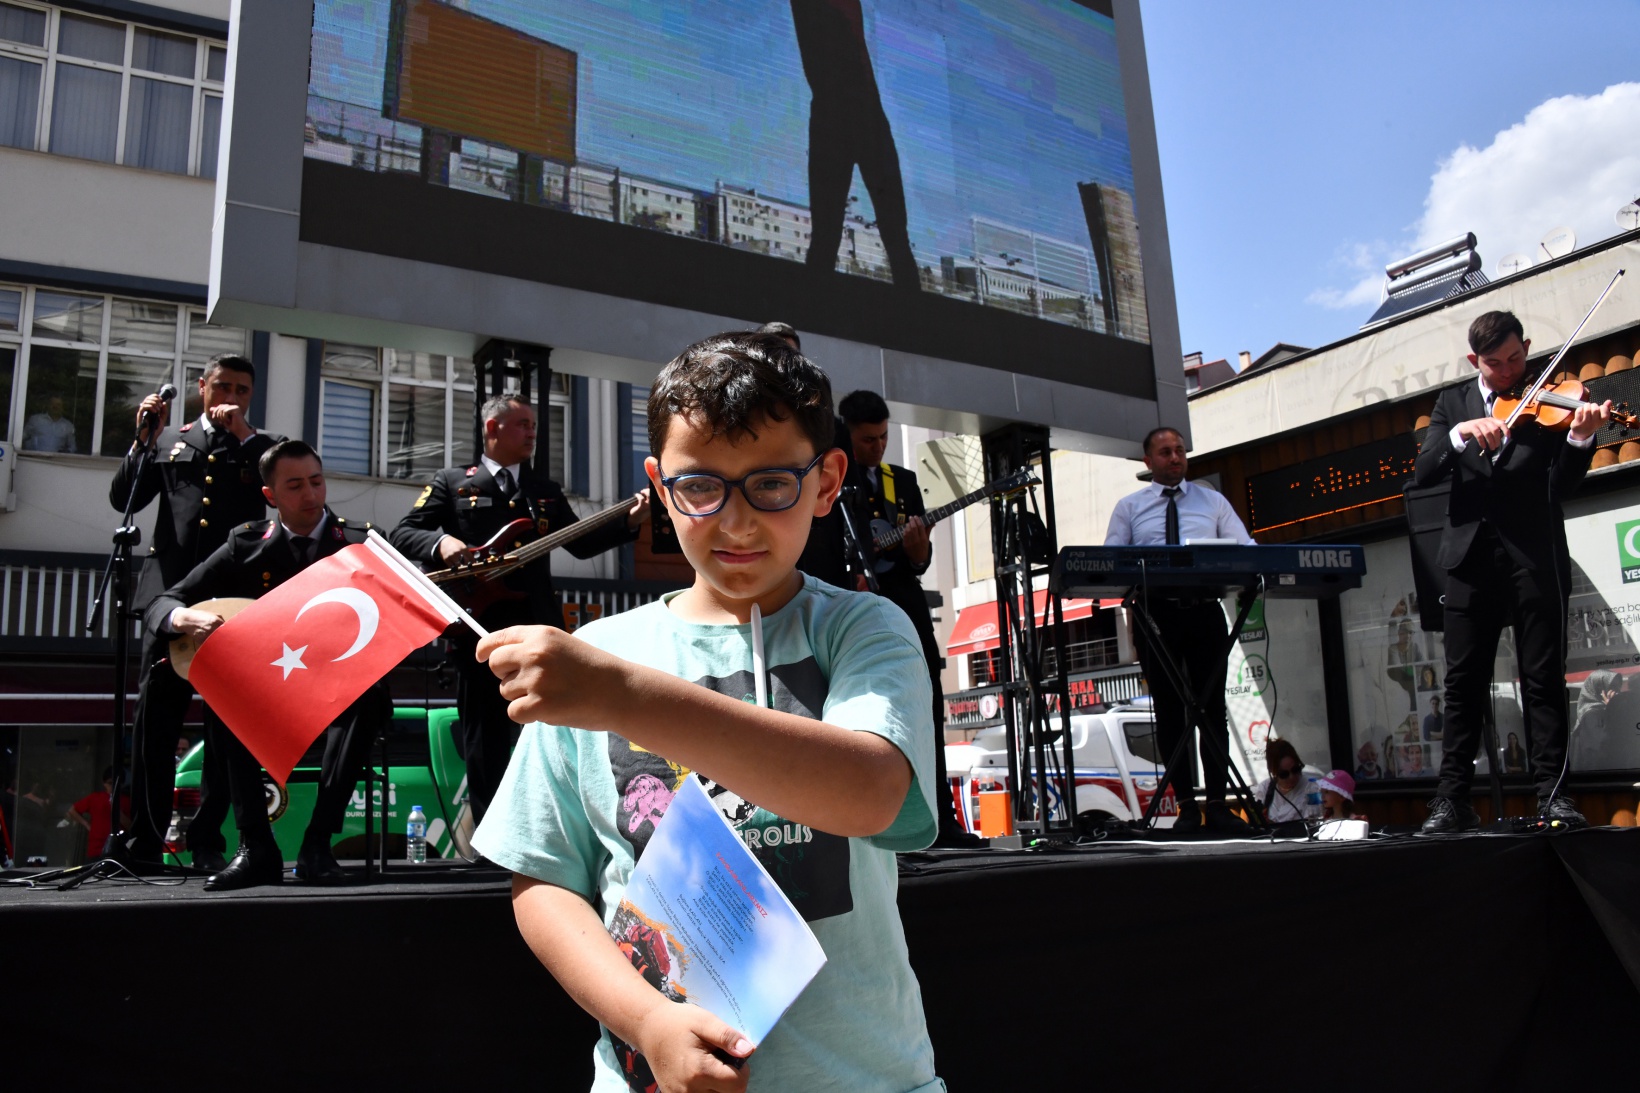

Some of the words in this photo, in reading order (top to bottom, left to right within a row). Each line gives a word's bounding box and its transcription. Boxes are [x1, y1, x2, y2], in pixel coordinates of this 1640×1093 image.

[1065, 558, 1115, 572] OĞUZHAN
[1298, 549, 1353, 568] KORG
[1245, 665, 1264, 680] 115
